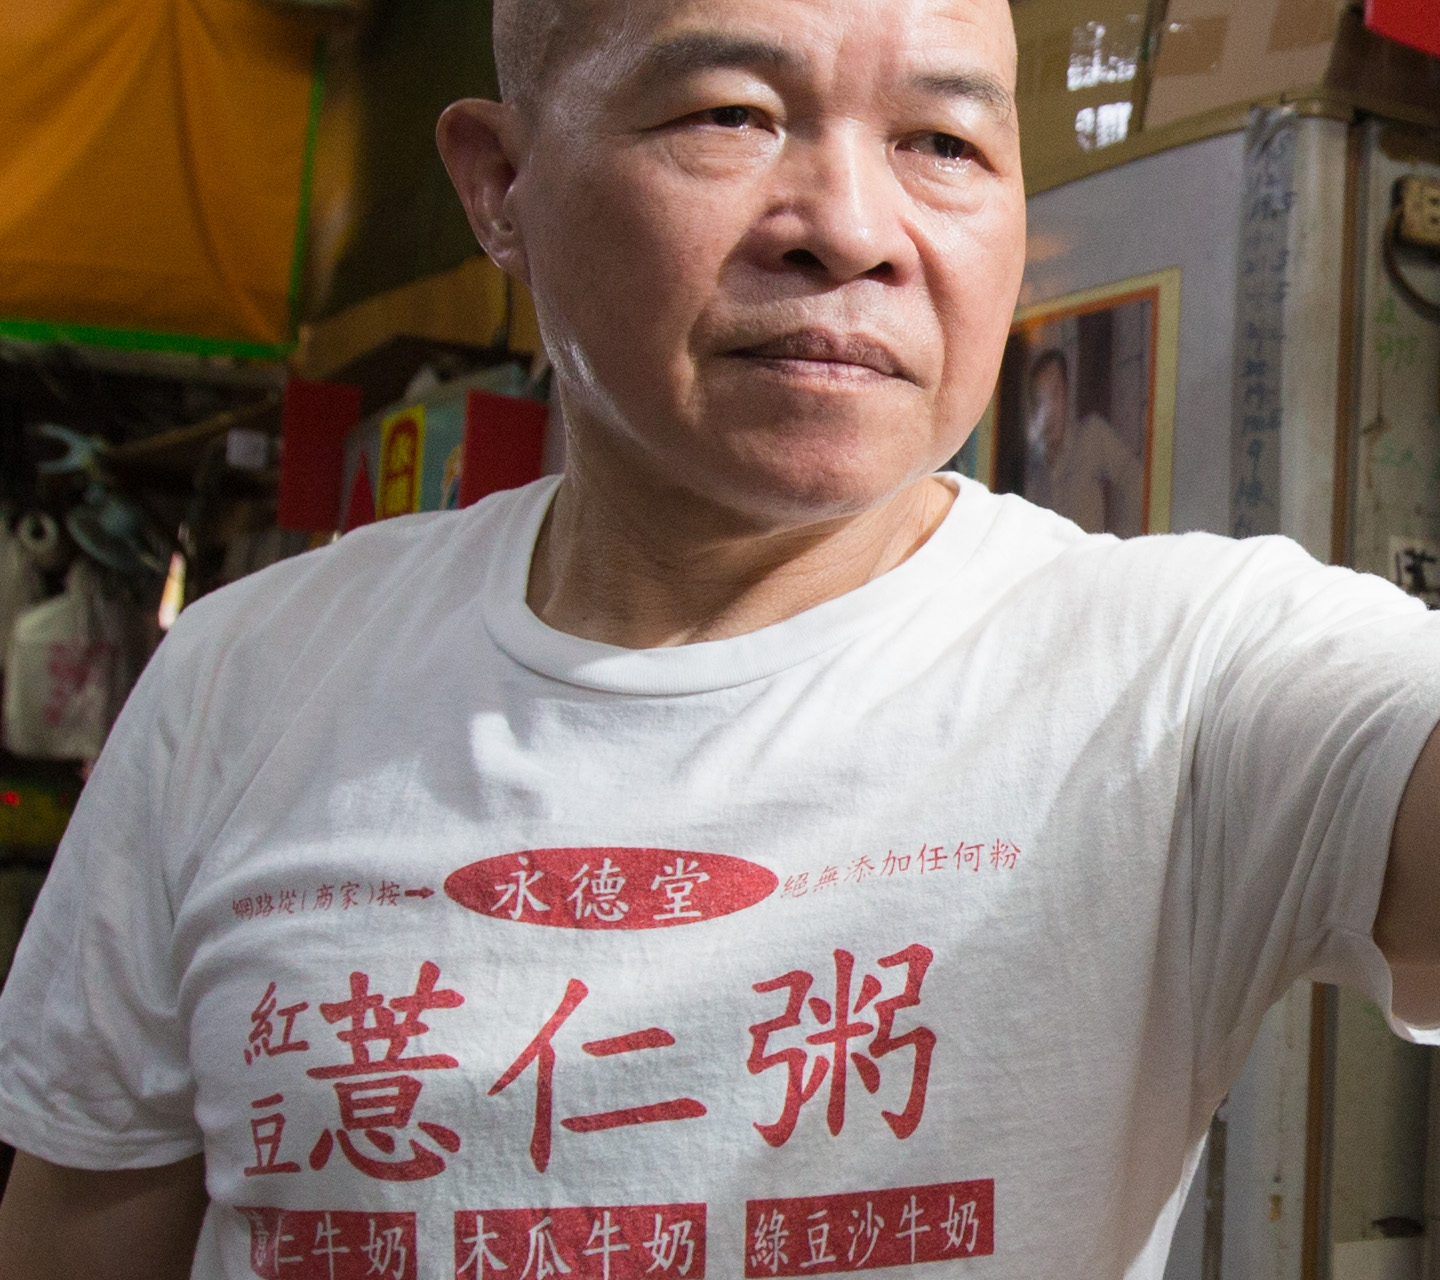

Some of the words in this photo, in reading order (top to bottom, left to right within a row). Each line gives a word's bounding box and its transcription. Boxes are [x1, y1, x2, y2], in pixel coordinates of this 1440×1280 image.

[492, 854, 711, 924] 永德堂
[779, 838, 1022, 899] 絕無添加任何粉
[243, 980, 311, 1177] 紅豆
[306, 942, 935, 1183] 薏仁粥
[749, 1193, 981, 1274] 綠豆沙牛奶
